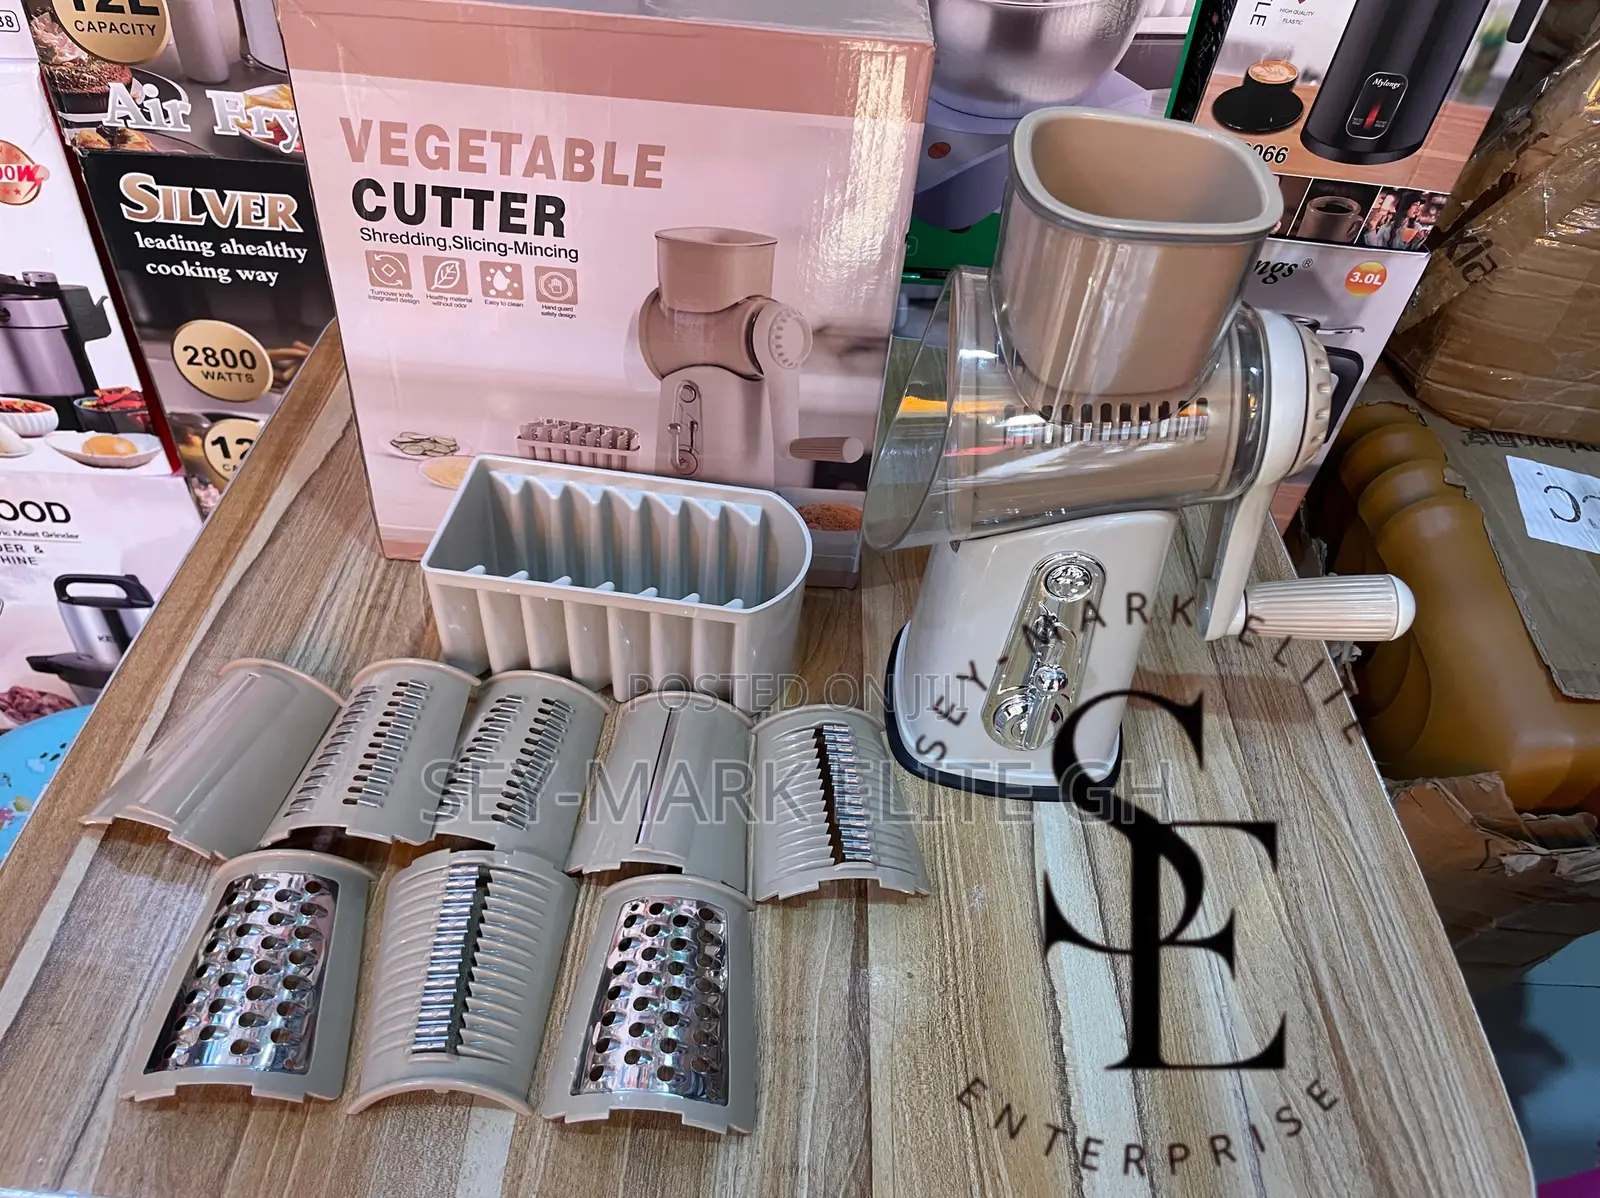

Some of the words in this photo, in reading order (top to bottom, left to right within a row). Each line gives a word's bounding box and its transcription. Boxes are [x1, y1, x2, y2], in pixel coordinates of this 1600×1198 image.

[74, 20, 156, 36] CAPACITY
[102, 82, 191, 132] Air
[206, 89, 300, 153] Fry
[339, 117, 666, 189] VEGETABLE
[119, 172, 303, 232] SILVER
[352, 178, 566, 238] CUTTER
[134, 231, 215, 257] leading
[220, 237, 308, 264] ahealthy
[145, 260, 231, 283] cooking
[236, 268, 279, 287] way
[1350, 271, 1382, 286] 3.0L
[370, 289, 397, 297] Turnover
[400, 297, 420, 305] design
[426, 294, 448, 302] Healthy
[558, 312, 576, 320] design
[183, 346, 256, 370] 2800
[200, 370, 255, 384] WATTS
[0, 499, 71, 523] OOD
